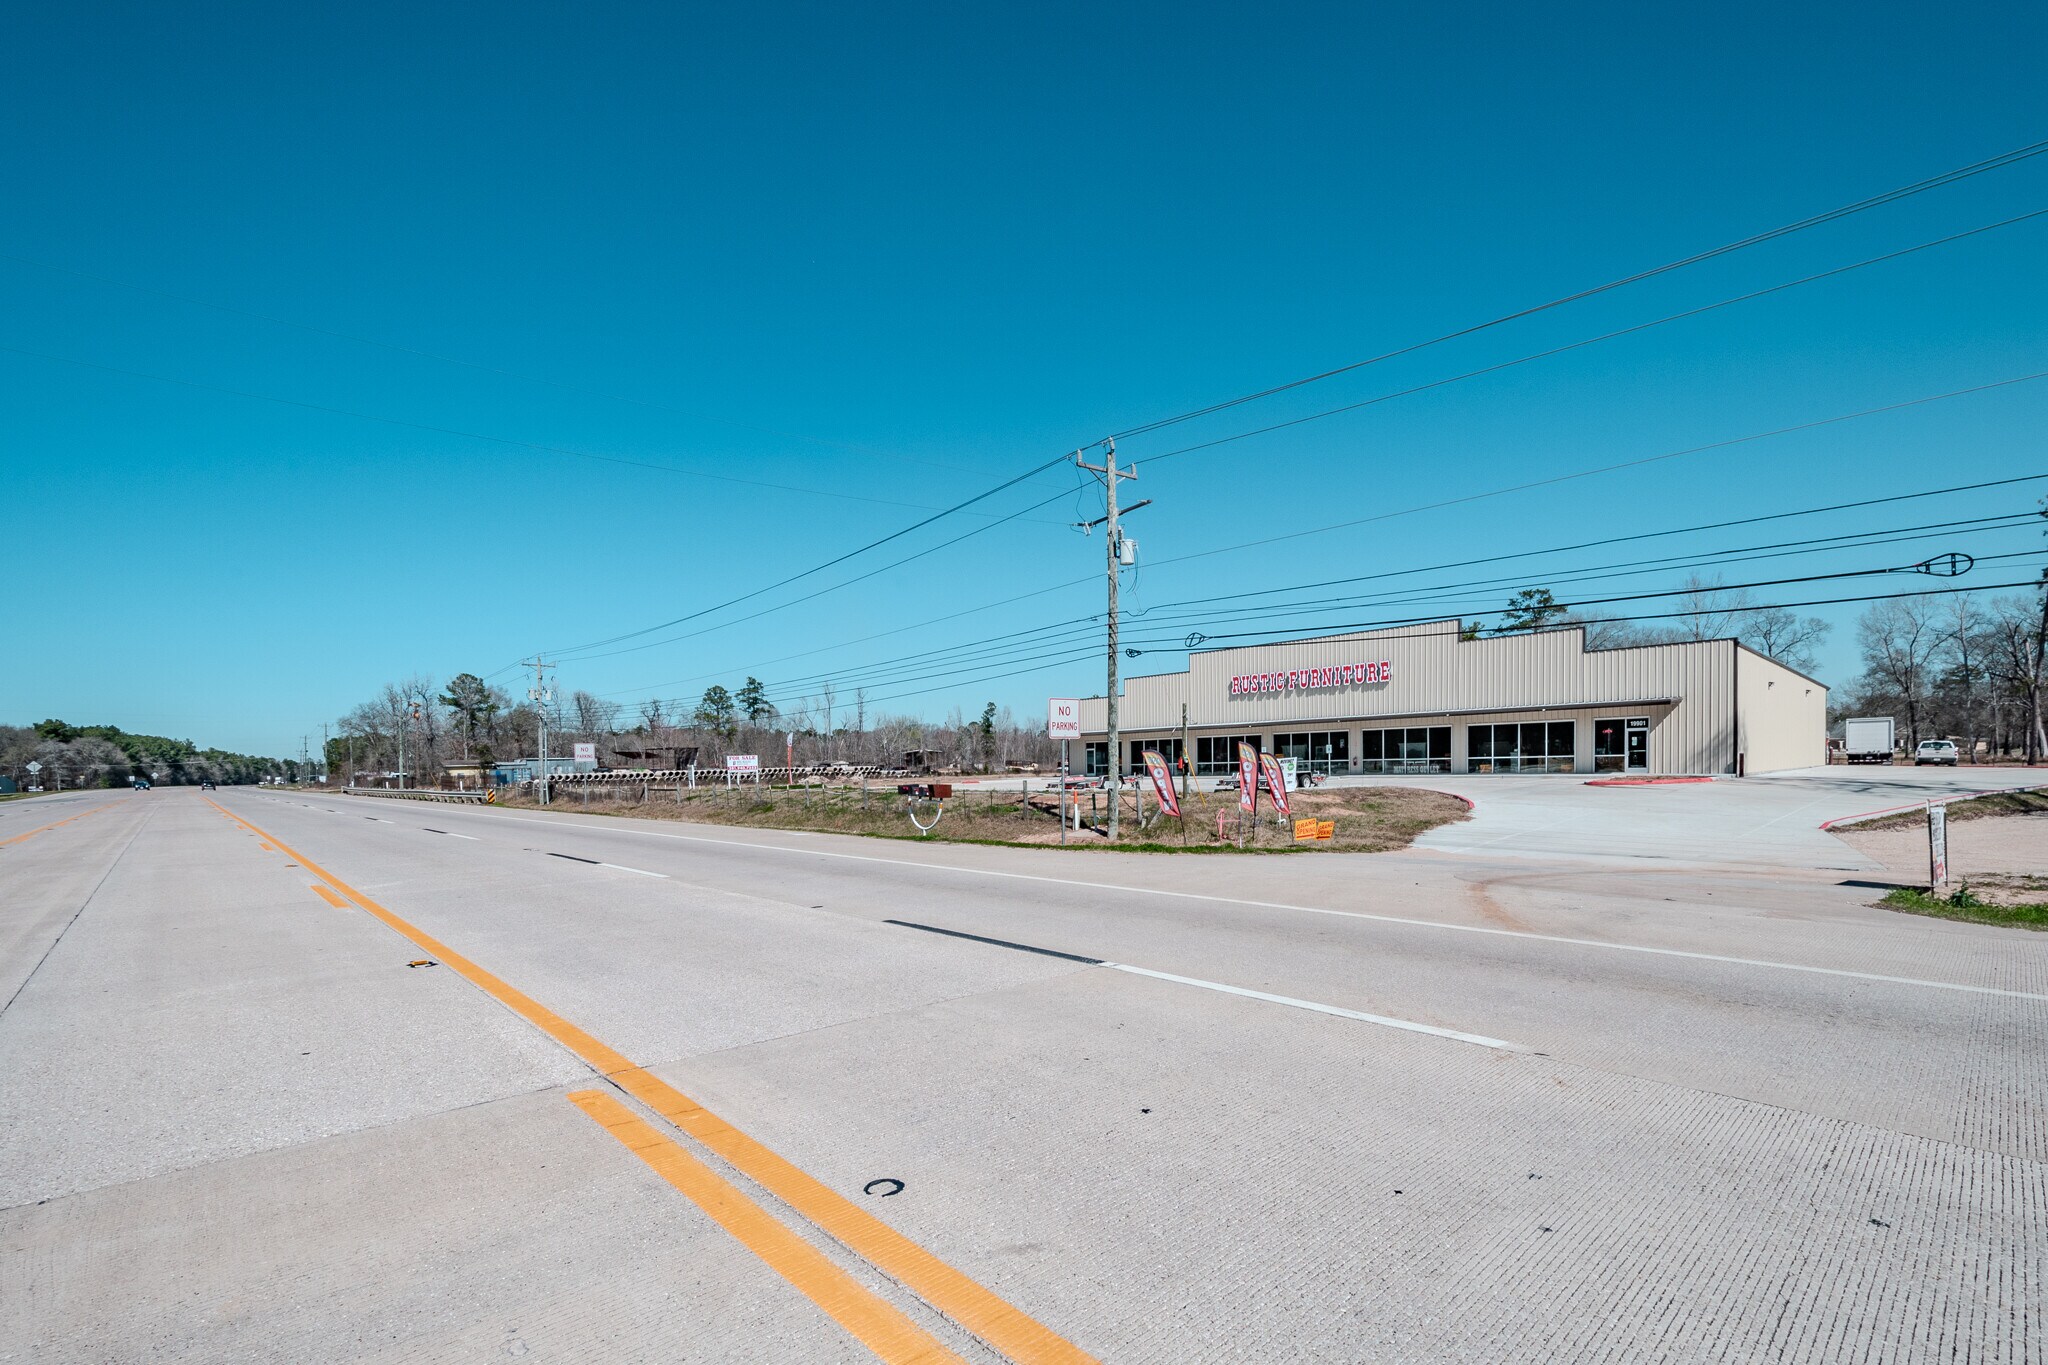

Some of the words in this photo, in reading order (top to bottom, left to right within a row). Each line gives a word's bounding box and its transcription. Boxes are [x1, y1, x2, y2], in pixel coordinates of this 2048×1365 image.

[1232, 671, 1285, 694] RUSTIC
[1288, 660, 1391, 690] FURNITURE
[1058, 706, 1071, 716] NO
[1052, 722, 1078, 730] PARKING
[1296, 819, 1316, 830] GRAND
